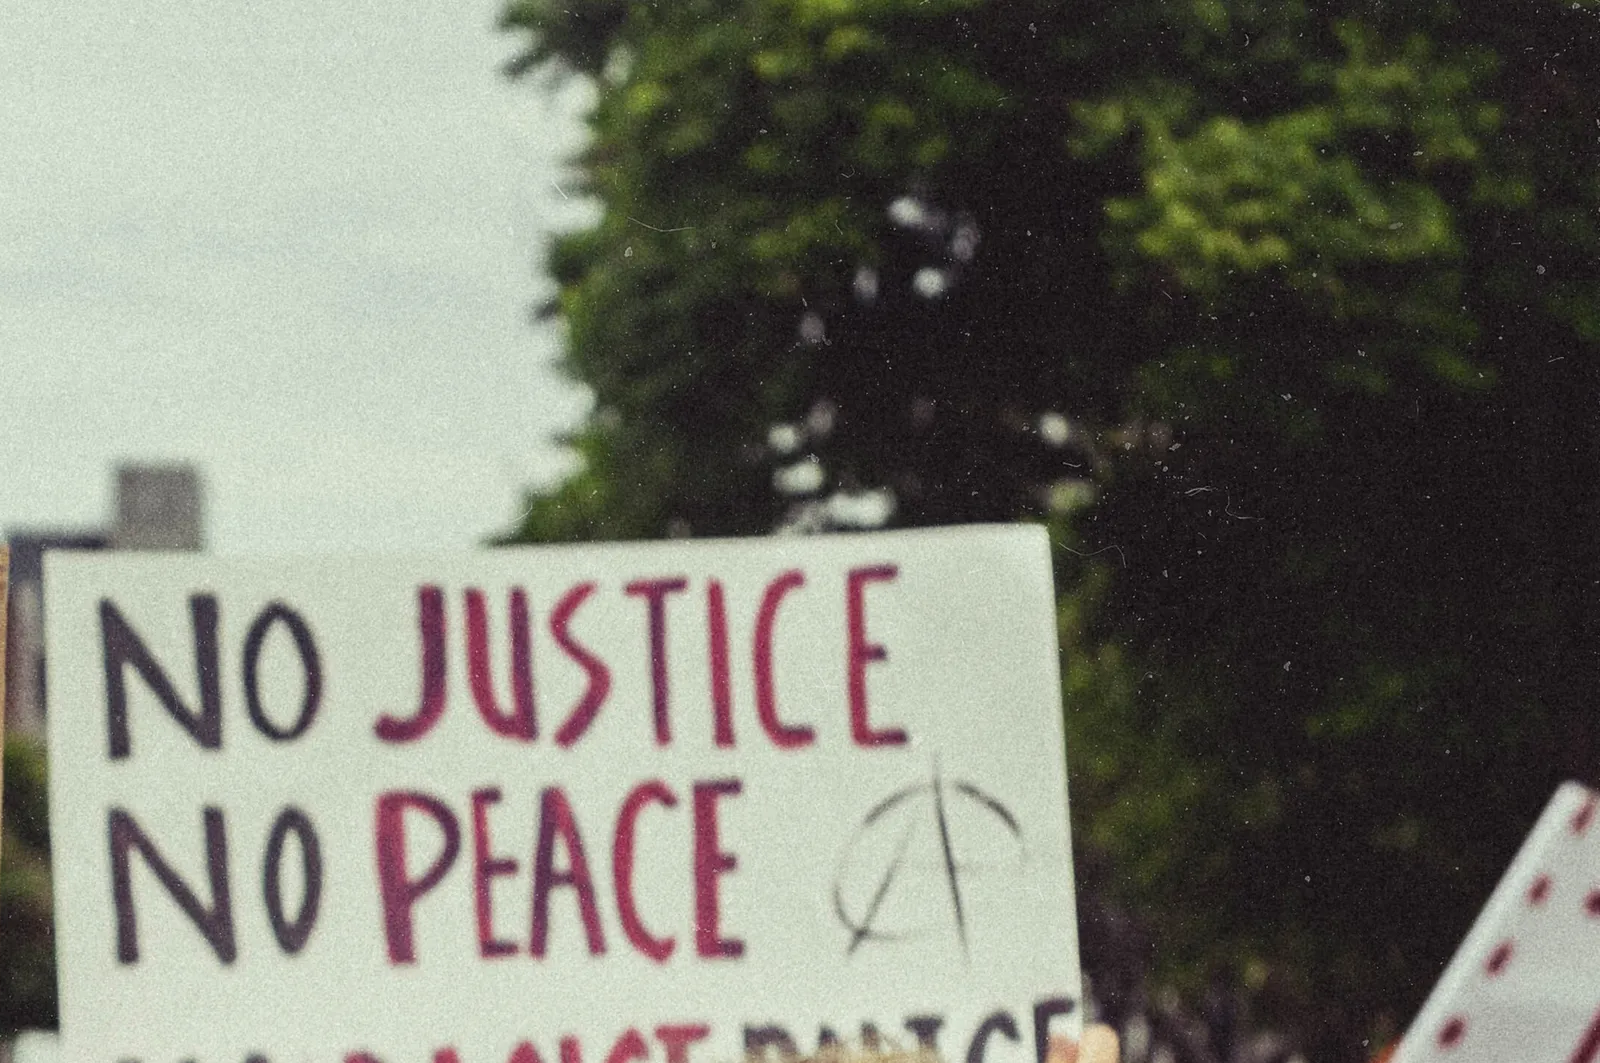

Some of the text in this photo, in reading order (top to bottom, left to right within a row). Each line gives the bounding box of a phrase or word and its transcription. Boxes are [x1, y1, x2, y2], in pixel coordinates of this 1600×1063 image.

[98, 565, 911, 761] NO JUSTICE
[108, 778, 747, 966] NO PEACE
